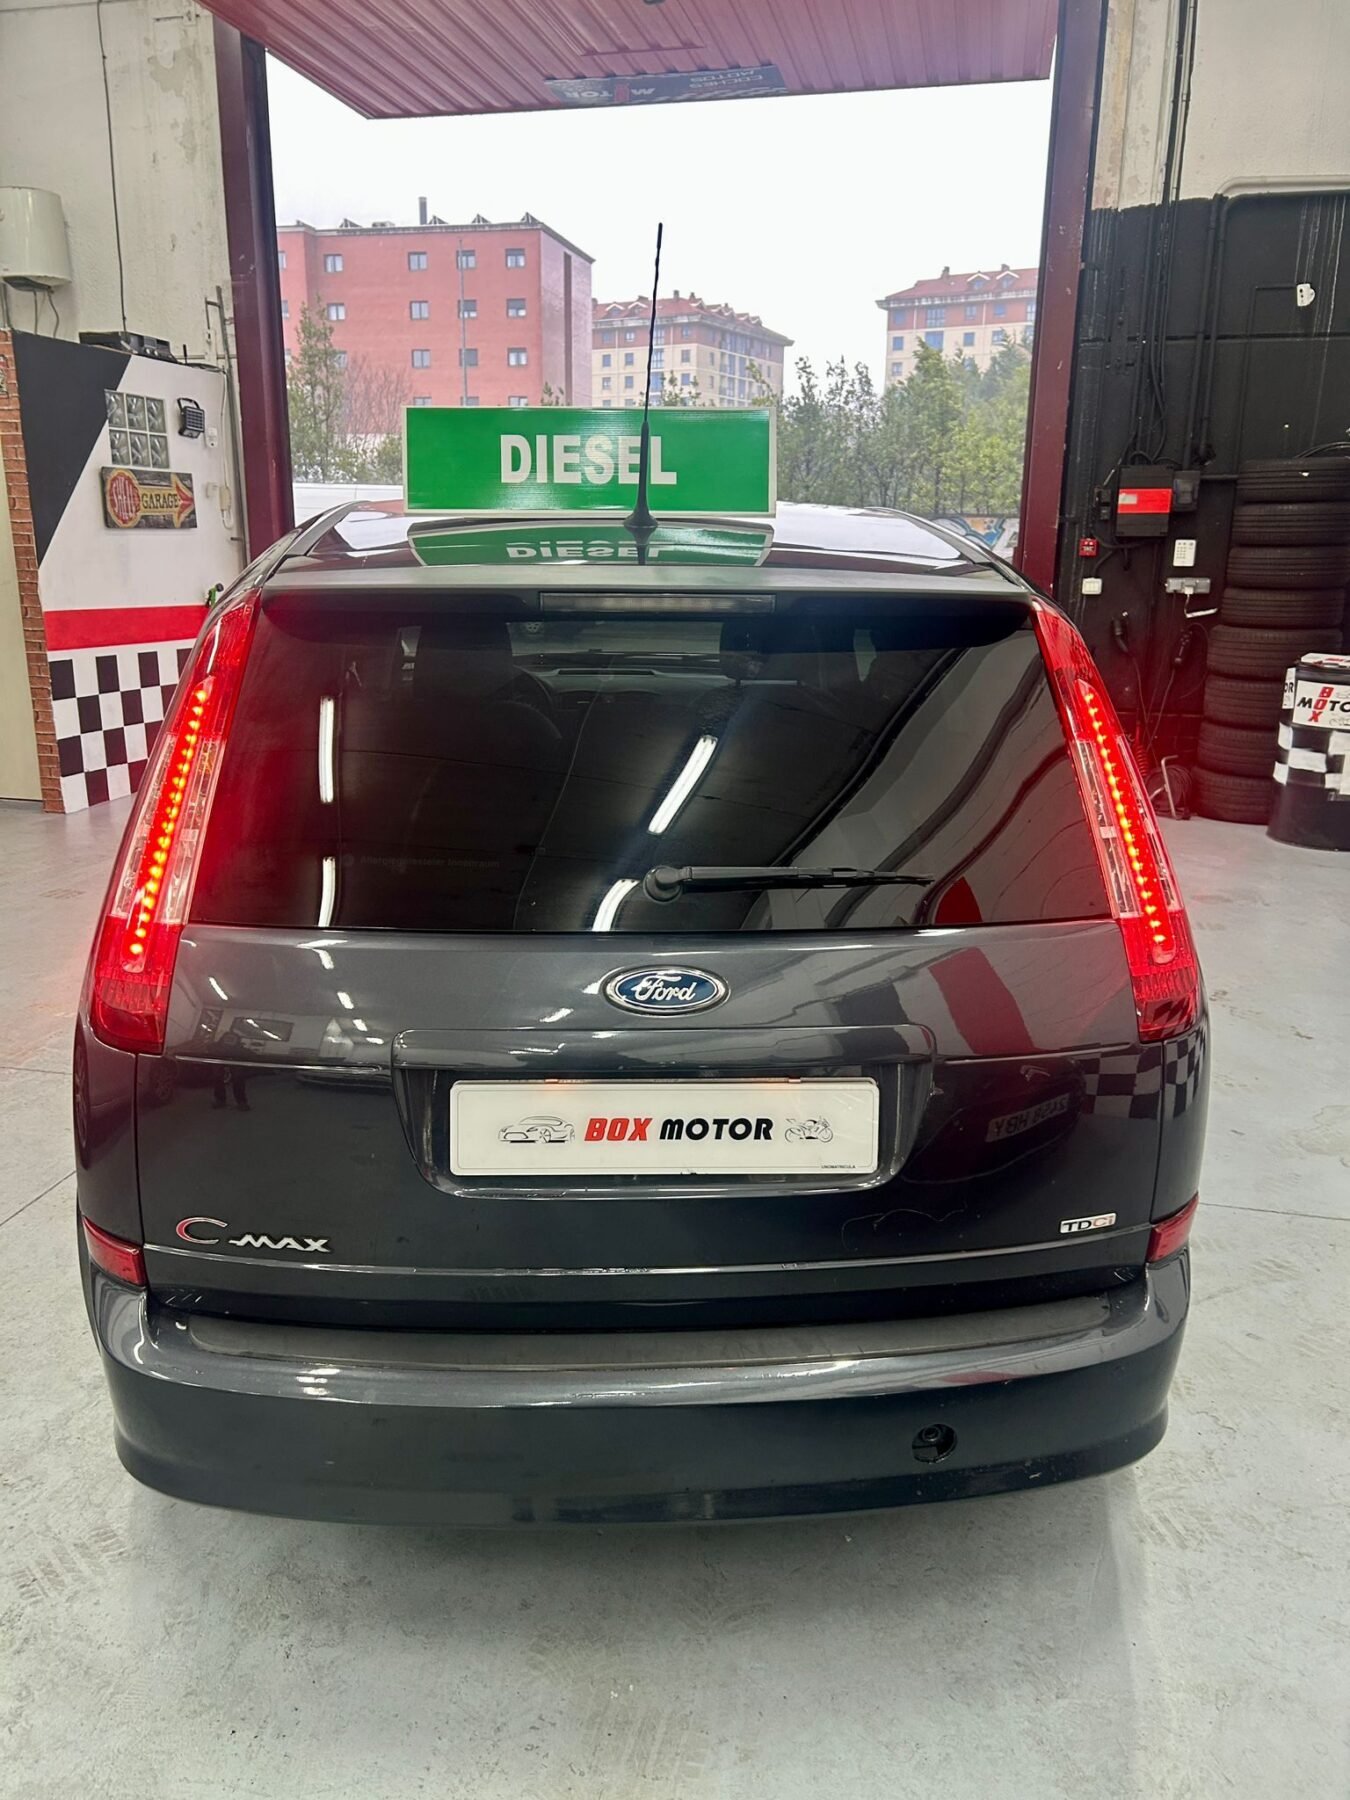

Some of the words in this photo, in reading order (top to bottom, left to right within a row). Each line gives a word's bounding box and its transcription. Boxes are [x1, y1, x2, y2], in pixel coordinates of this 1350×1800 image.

[500, 434, 677, 485] DIESEL
[141, 493, 179, 509] GARAGE
[631, 975, 697, 1001] Ford
[584, 1118, 653, 1141] BOX
[659, 1118, 774, 1140] MOTOR
